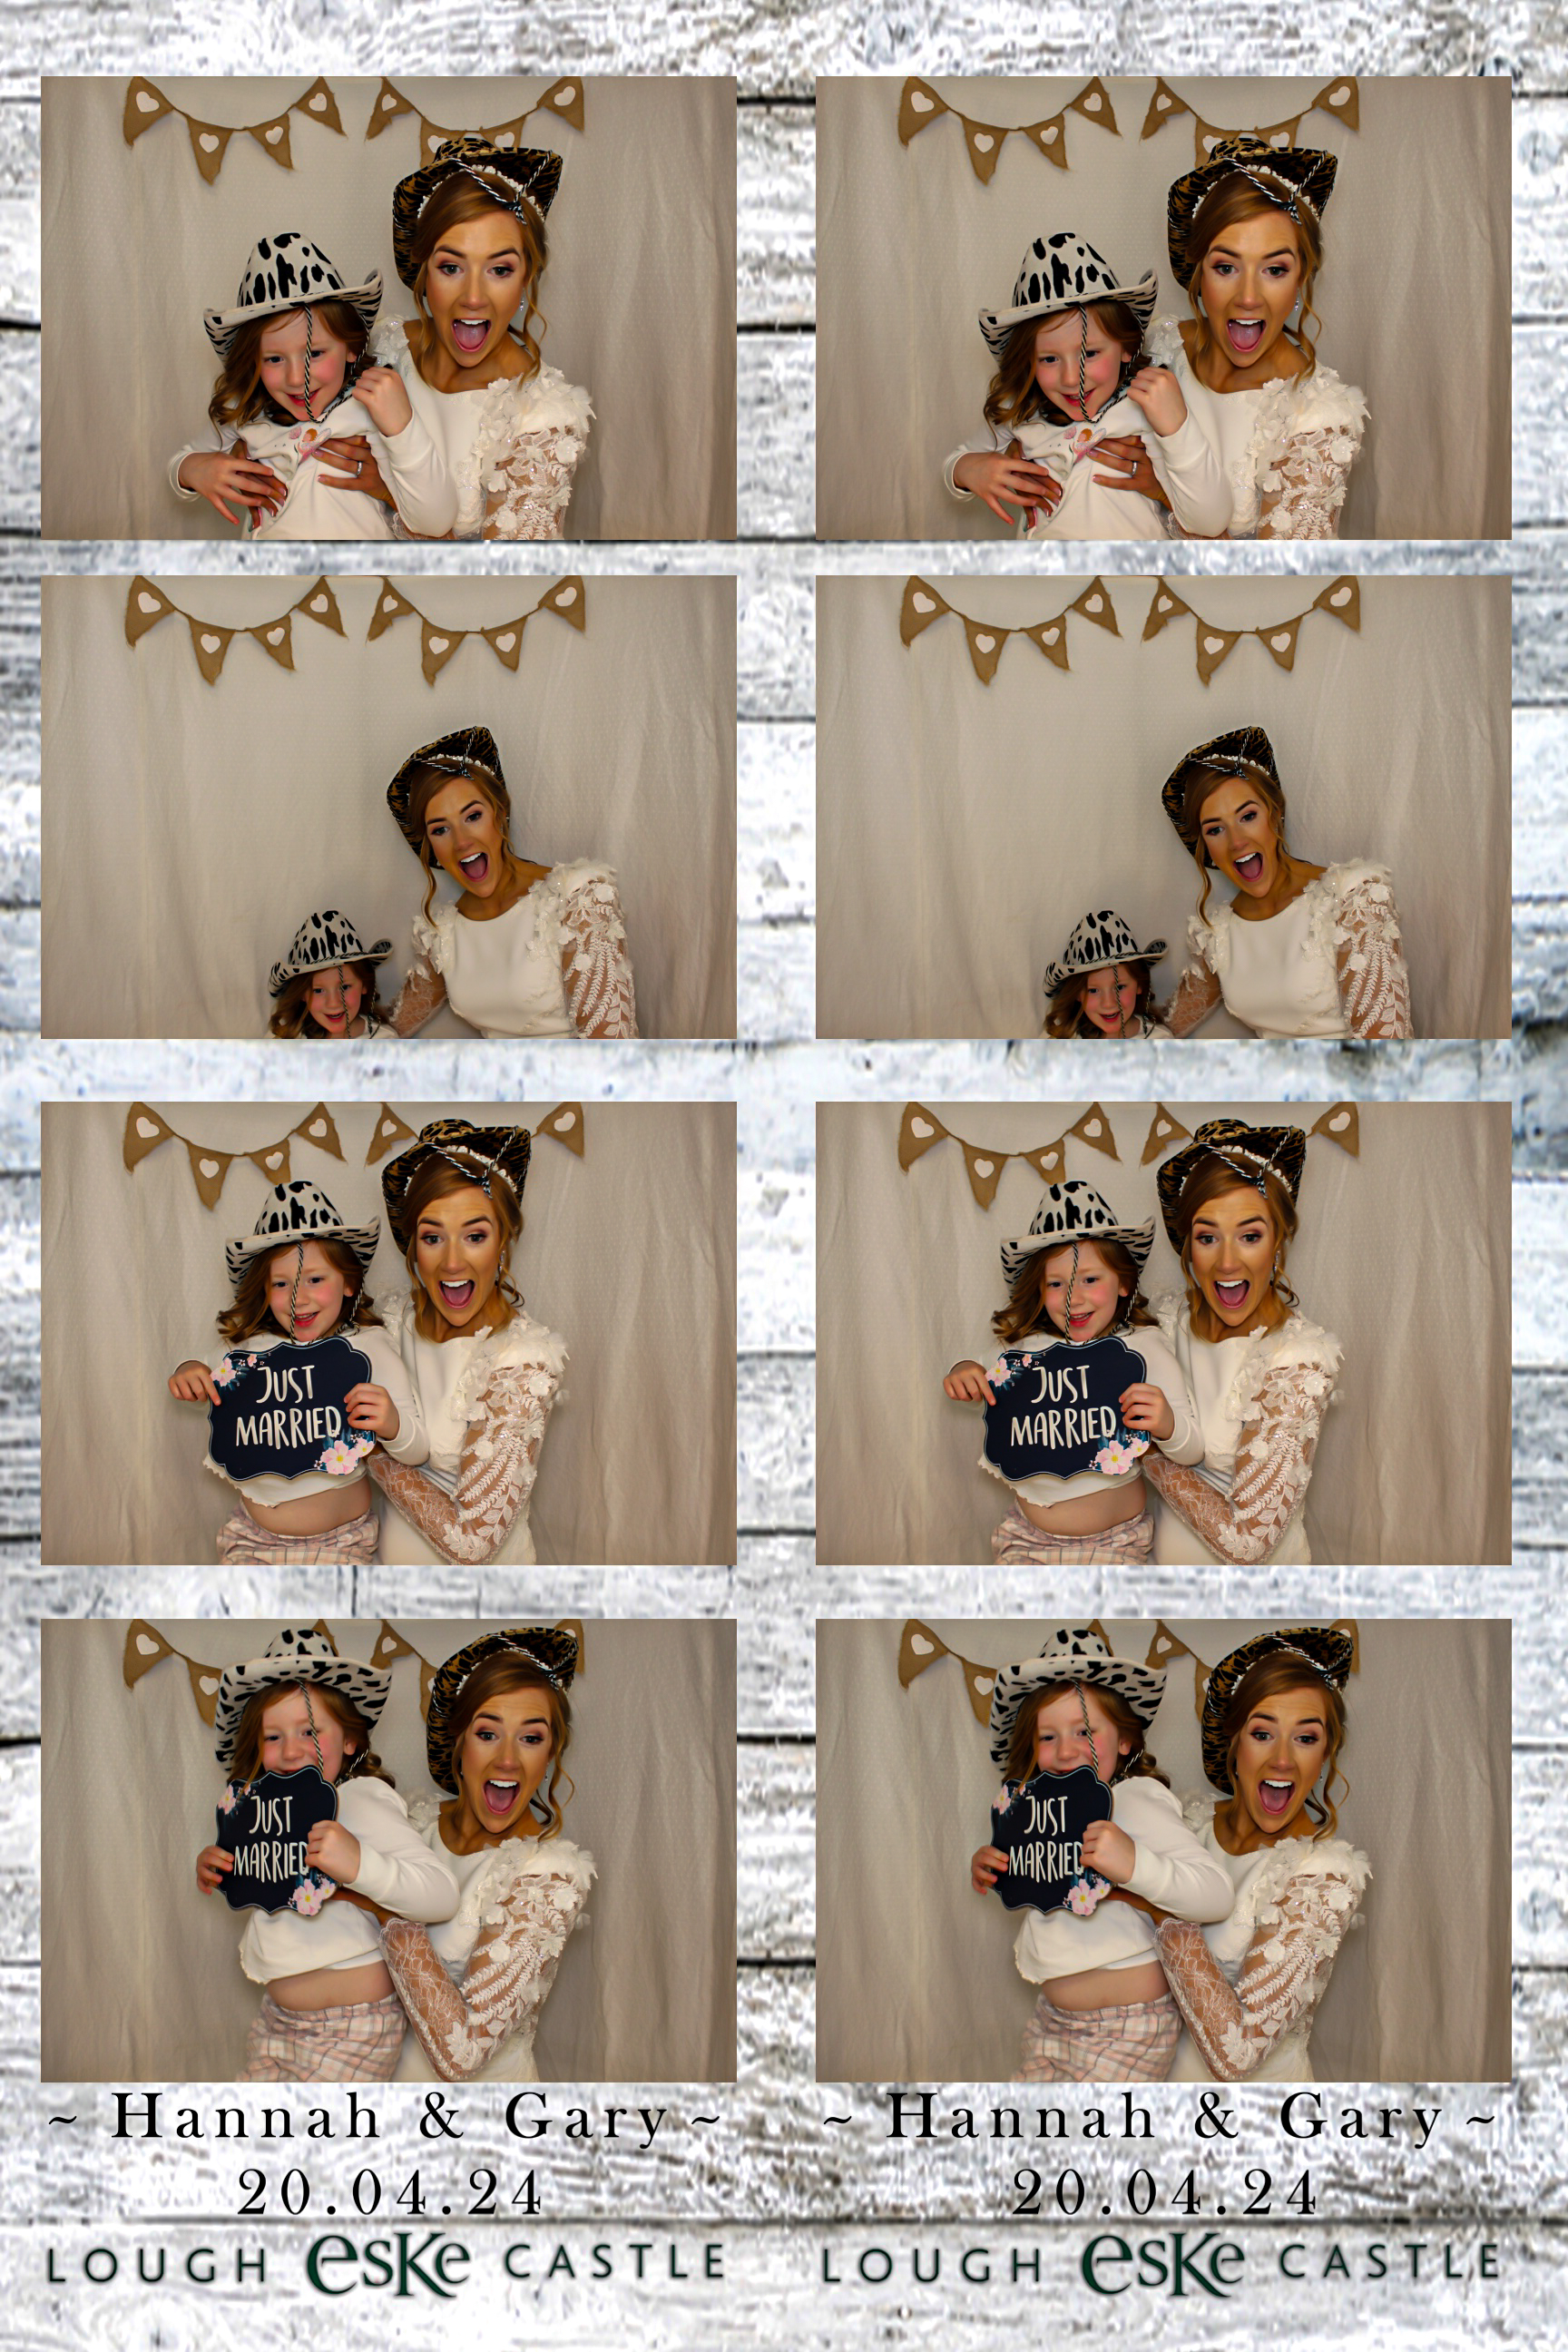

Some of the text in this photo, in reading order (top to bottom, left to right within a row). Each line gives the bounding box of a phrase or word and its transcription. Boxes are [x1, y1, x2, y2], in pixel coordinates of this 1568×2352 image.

[255, 1364, 316, 1404] JUST
[1030, 1364, 1091, 1404] JUST
[235, 1406, 342, 1450] MARRIED
[1010, 1406, 1117, 1450] MARRIED
[249, 1795, 293, 1837] JUST
[1024, 1795, 1068, 1837] JUST
[233, 1840, 309, 1884] MARRIED
[1008, 1840, 1084, 1884] MARRIED
